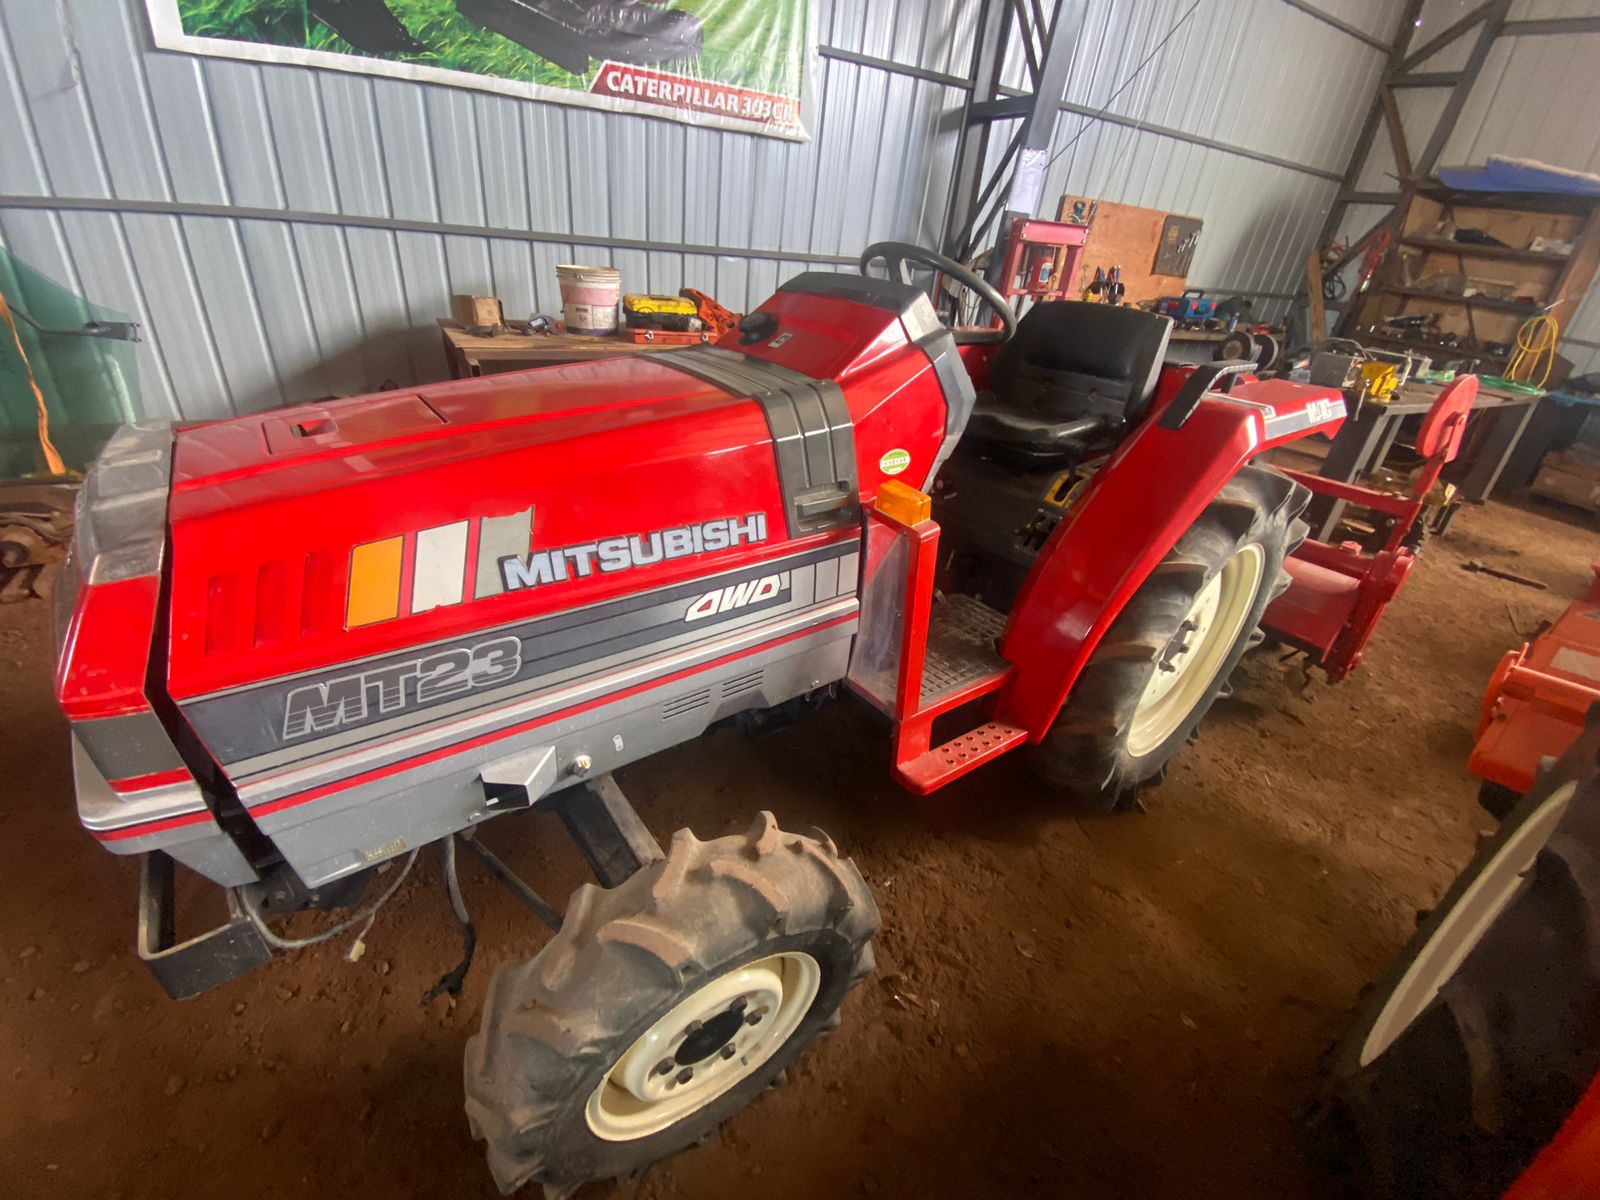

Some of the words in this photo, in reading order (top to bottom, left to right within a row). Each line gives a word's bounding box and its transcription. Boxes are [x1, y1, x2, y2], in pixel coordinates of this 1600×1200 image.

[606, 71, 739, 113] CATERPILLAR
[500, 513, 767, 592] MITSUBISHI
[684, 574, 781, 622] 4WD
[282, 636, 522, 740] MT23
